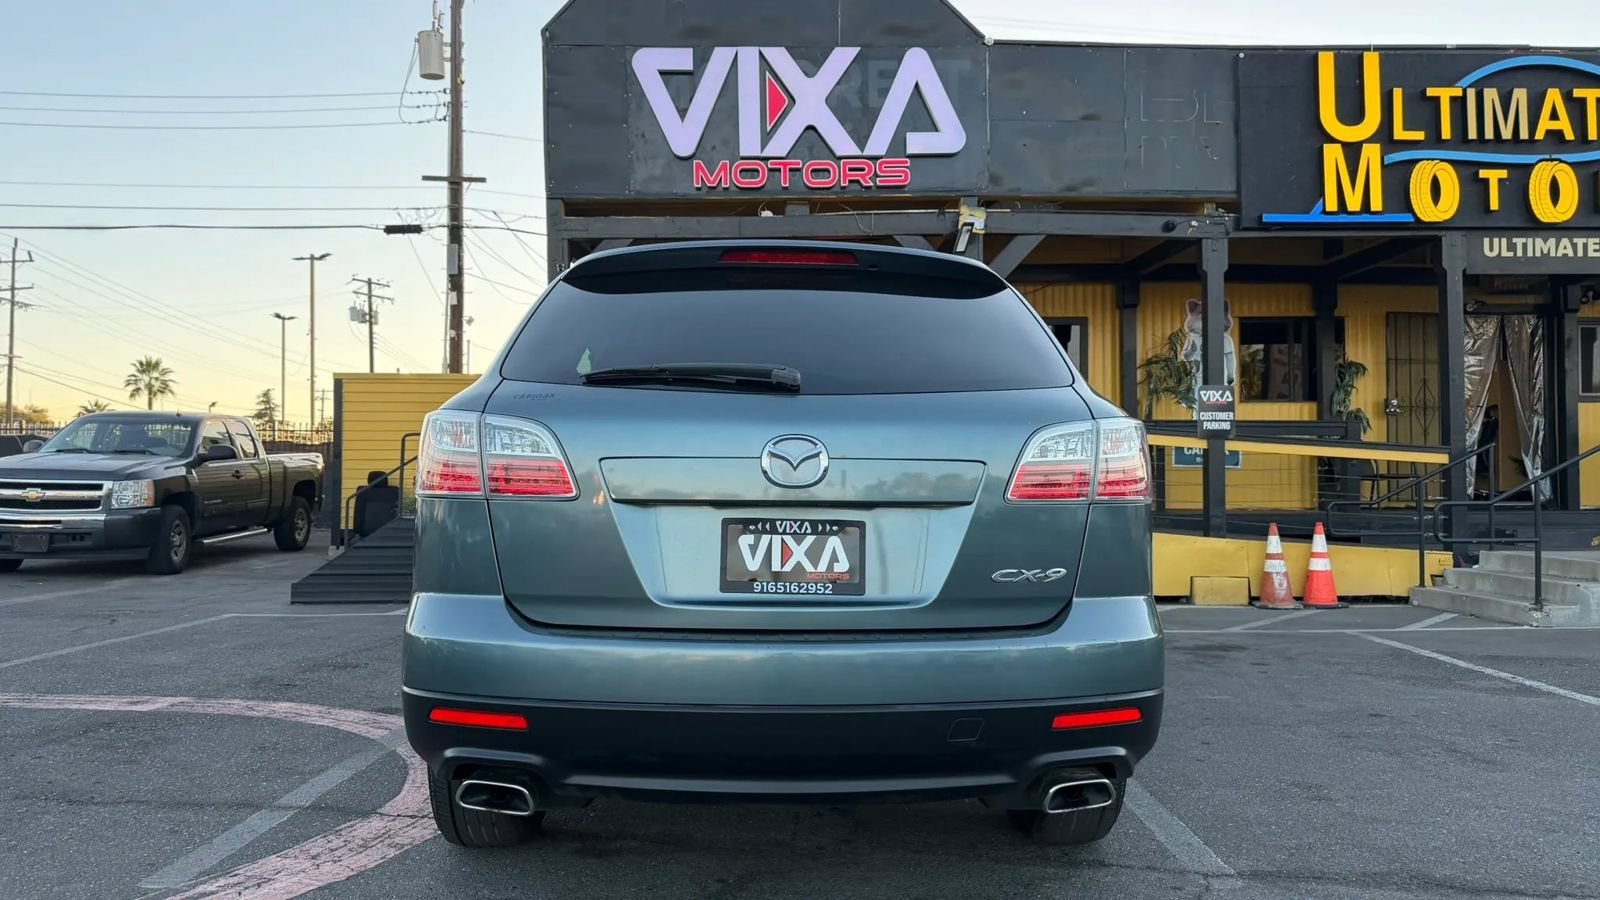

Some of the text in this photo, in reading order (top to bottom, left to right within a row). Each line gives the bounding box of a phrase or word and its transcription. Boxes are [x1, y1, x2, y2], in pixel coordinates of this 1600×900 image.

[632, 47, 967, 158] VIXA
[693, 159, 911, 188] MOTORS
[1483, 237, 1600, 258] ULTIMATE
[1199, 390, 1234, 402] VIXA
[1200, 411, 1234, 420] CUSTOMER
[1203, 421, 1231, 430] PARKING
[776, 521, 812, 534] VIXA
[738, 535, 850, 572] VIXA
[806, 572, 850, 580] MOTORS
[991, 568, 1068, 583] CX-9
[753, 582, 833, 595] 9165162952
